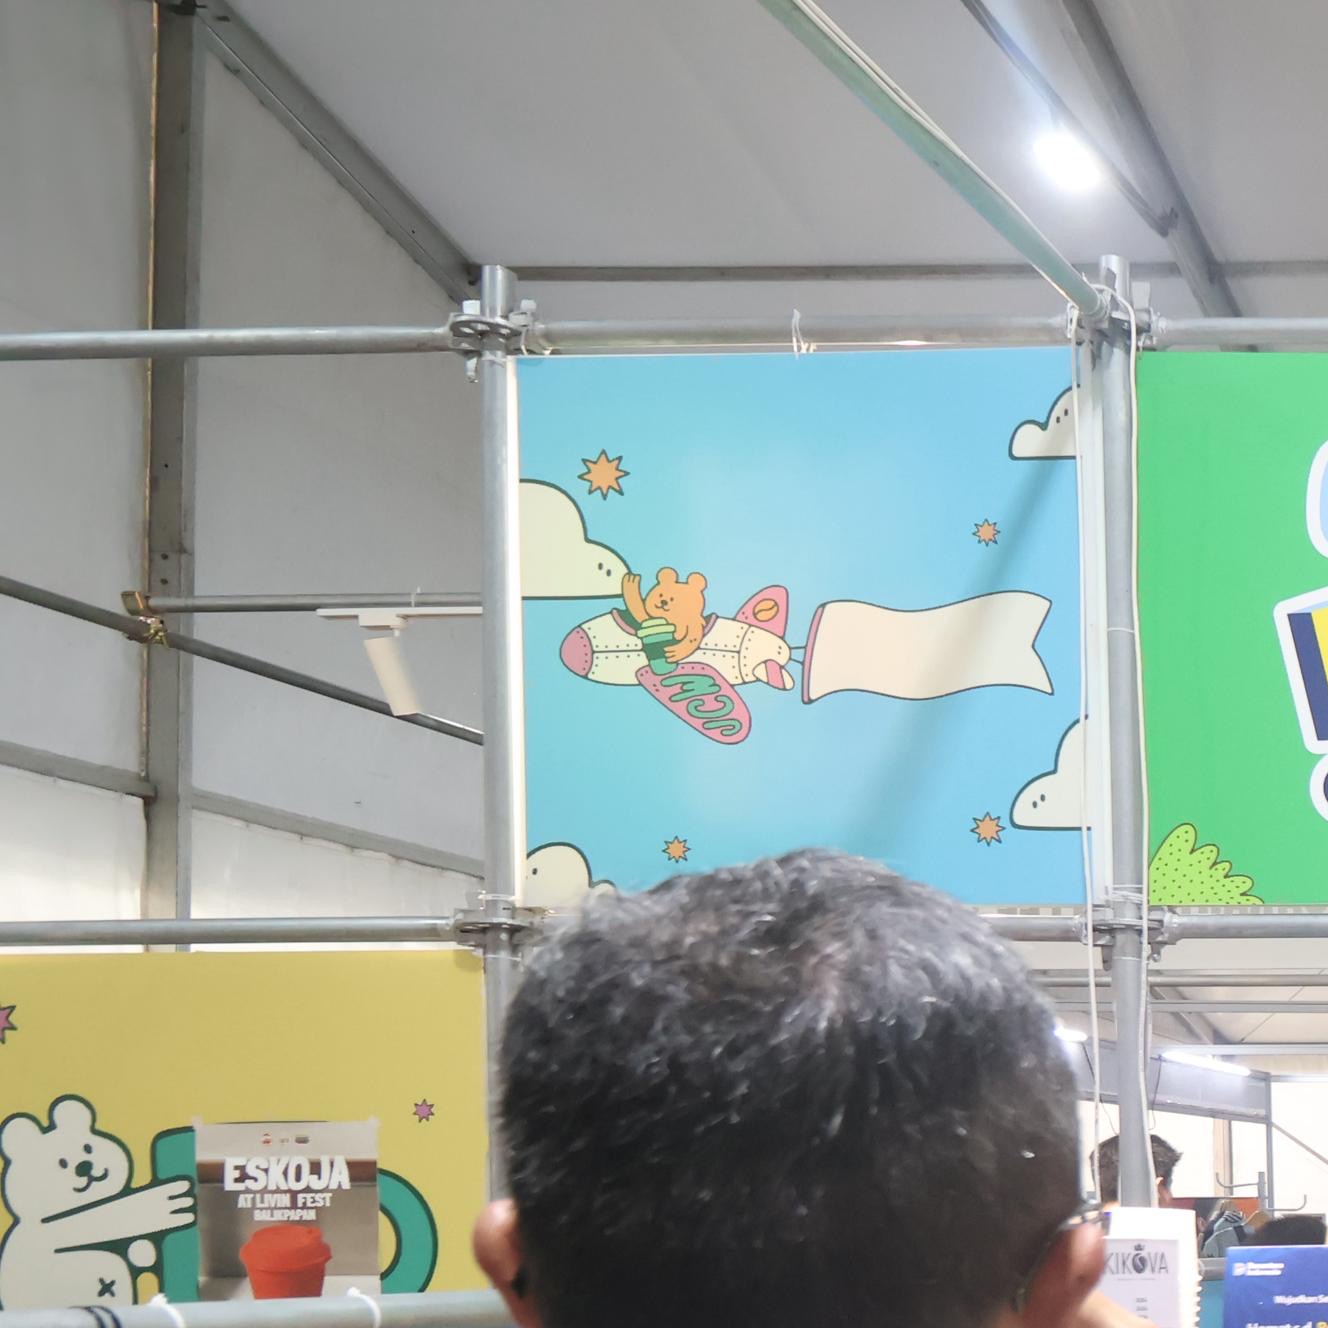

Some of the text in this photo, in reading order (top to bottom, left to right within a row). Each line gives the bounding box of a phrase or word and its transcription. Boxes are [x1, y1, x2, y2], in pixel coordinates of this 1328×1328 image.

[223, 1154, 351, 1191] ESKOJA
[237, 1193, 254, 1208] AT
[297, 1192, 333, 1208] FEST
[253, 1209, 317, 1221] BALIKPAPAN
